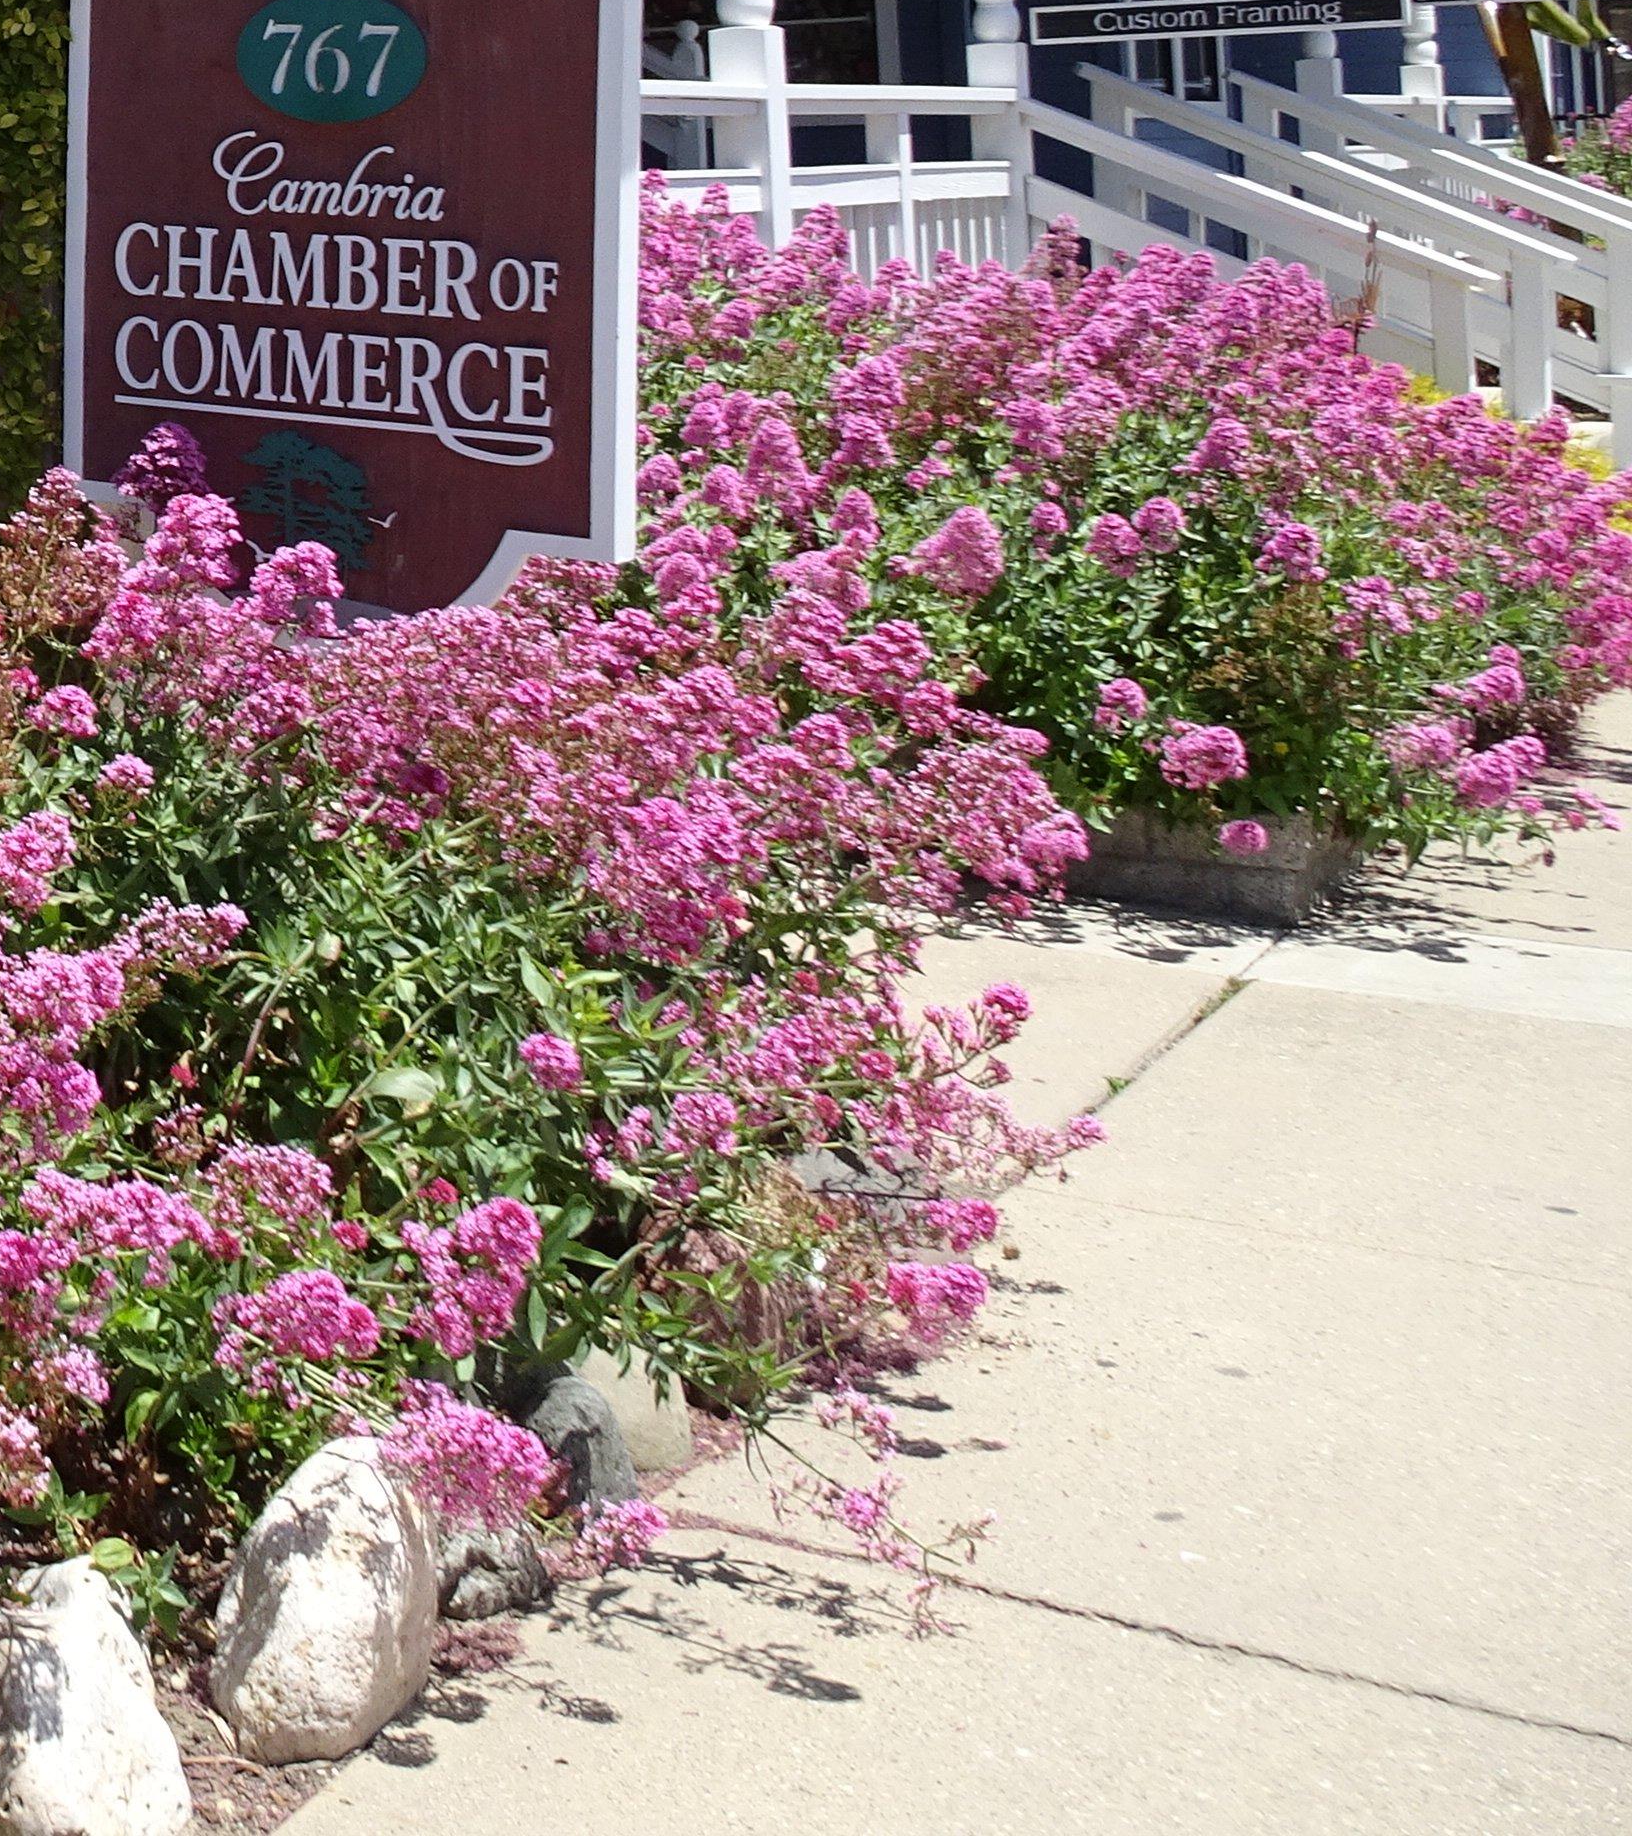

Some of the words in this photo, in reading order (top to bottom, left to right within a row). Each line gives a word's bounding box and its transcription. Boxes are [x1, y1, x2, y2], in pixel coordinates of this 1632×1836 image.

[263, 19, 398, 97] 767
[1094, 7, 1206, 32] Custom
[212, 130, 445, 221] Cambria
[115, 222, 480, 320] CHAMBER
[490, 258, 558, 312] OF
[115, 316, 552, 454] COMMERCE
